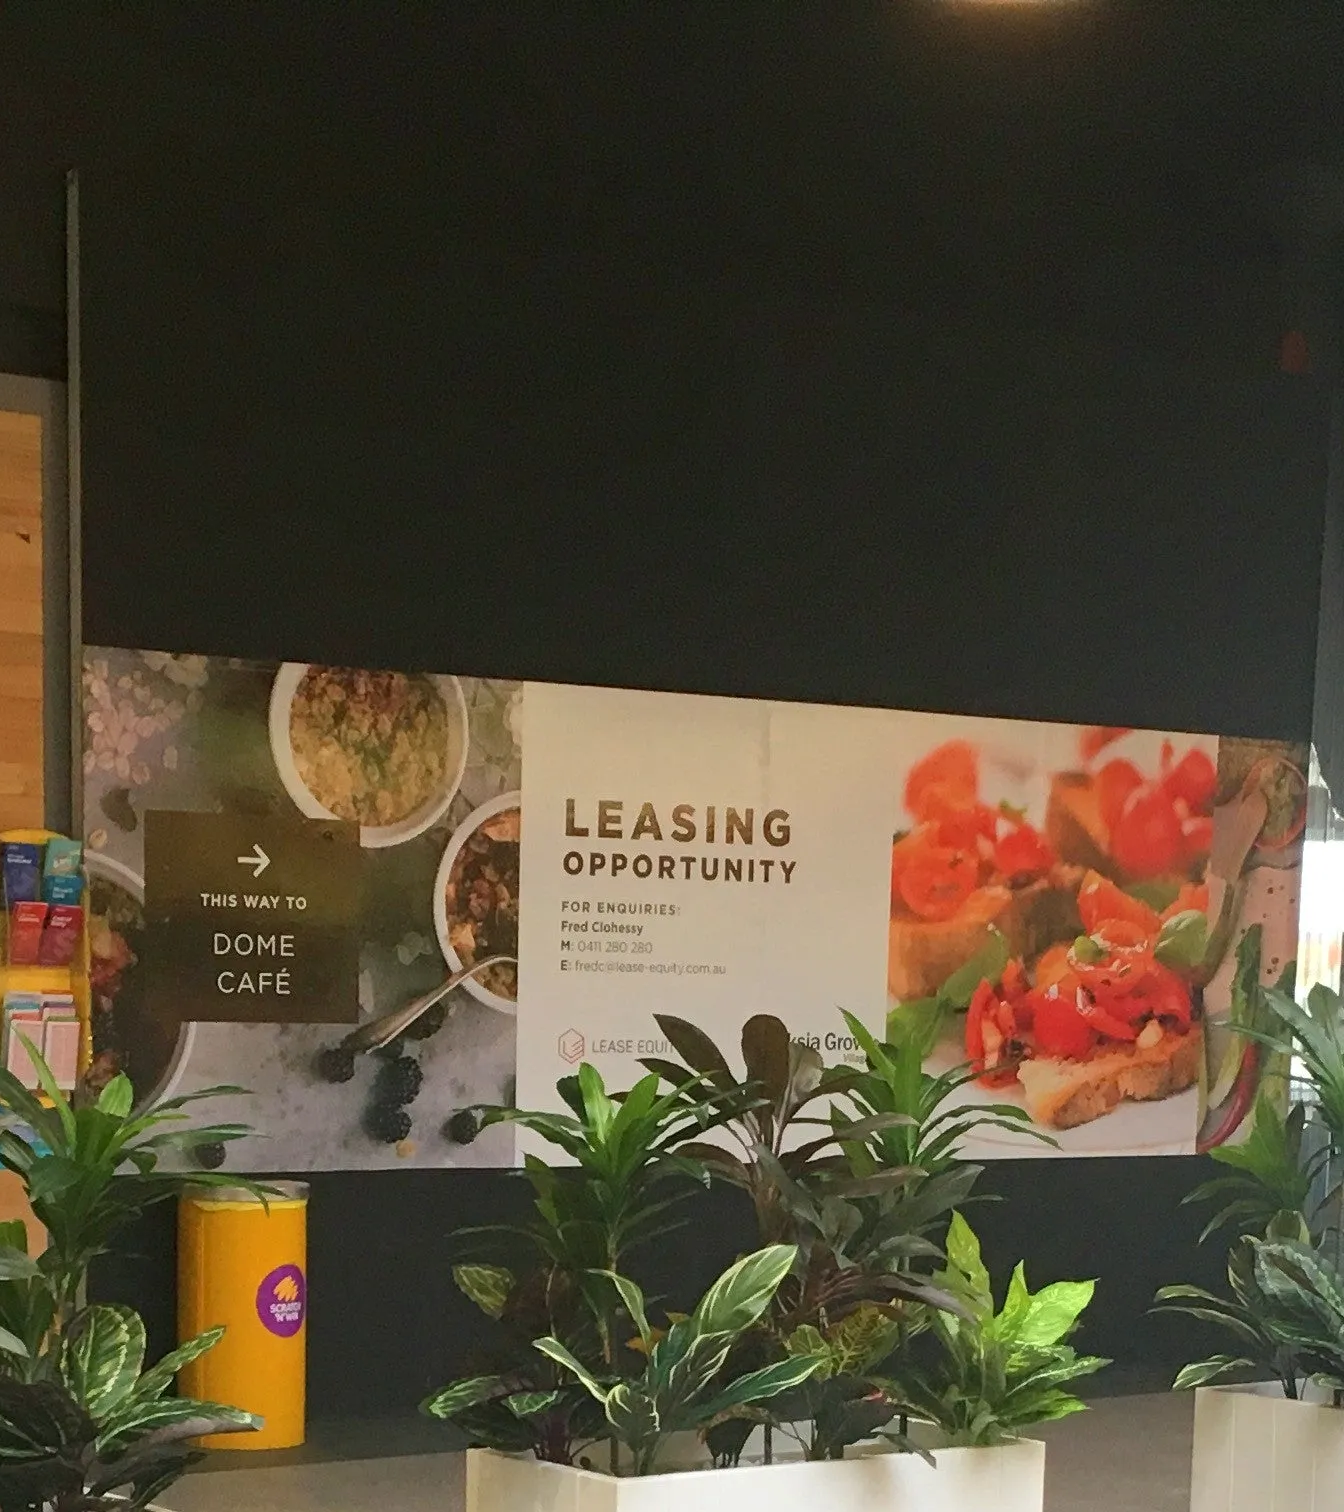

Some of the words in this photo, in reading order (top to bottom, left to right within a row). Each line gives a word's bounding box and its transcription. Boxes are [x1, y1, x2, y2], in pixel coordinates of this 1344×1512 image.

[565, 798, 791, 848] LEASING
[563, 851, 797, 884] OPPORTUNITY
[200, 893, 237, 908] THIS
[243, 894, 280, 909] WAY
[285, 896, 307, 910] TO
[561, 901, 590, 914] FOR
[561, 921, 588, 933] Fred
[592, 922, 644, 936] Clohessy
[213, 932, 295, 956] DOME
[577, 941, 602, 952] 0411
[605, 941, 627, 953] 280
[630, 942, 653, 954] 280
[217, 967, 291, 995] CAFÉ
[591, 1040, 634, 1053] LEASE
